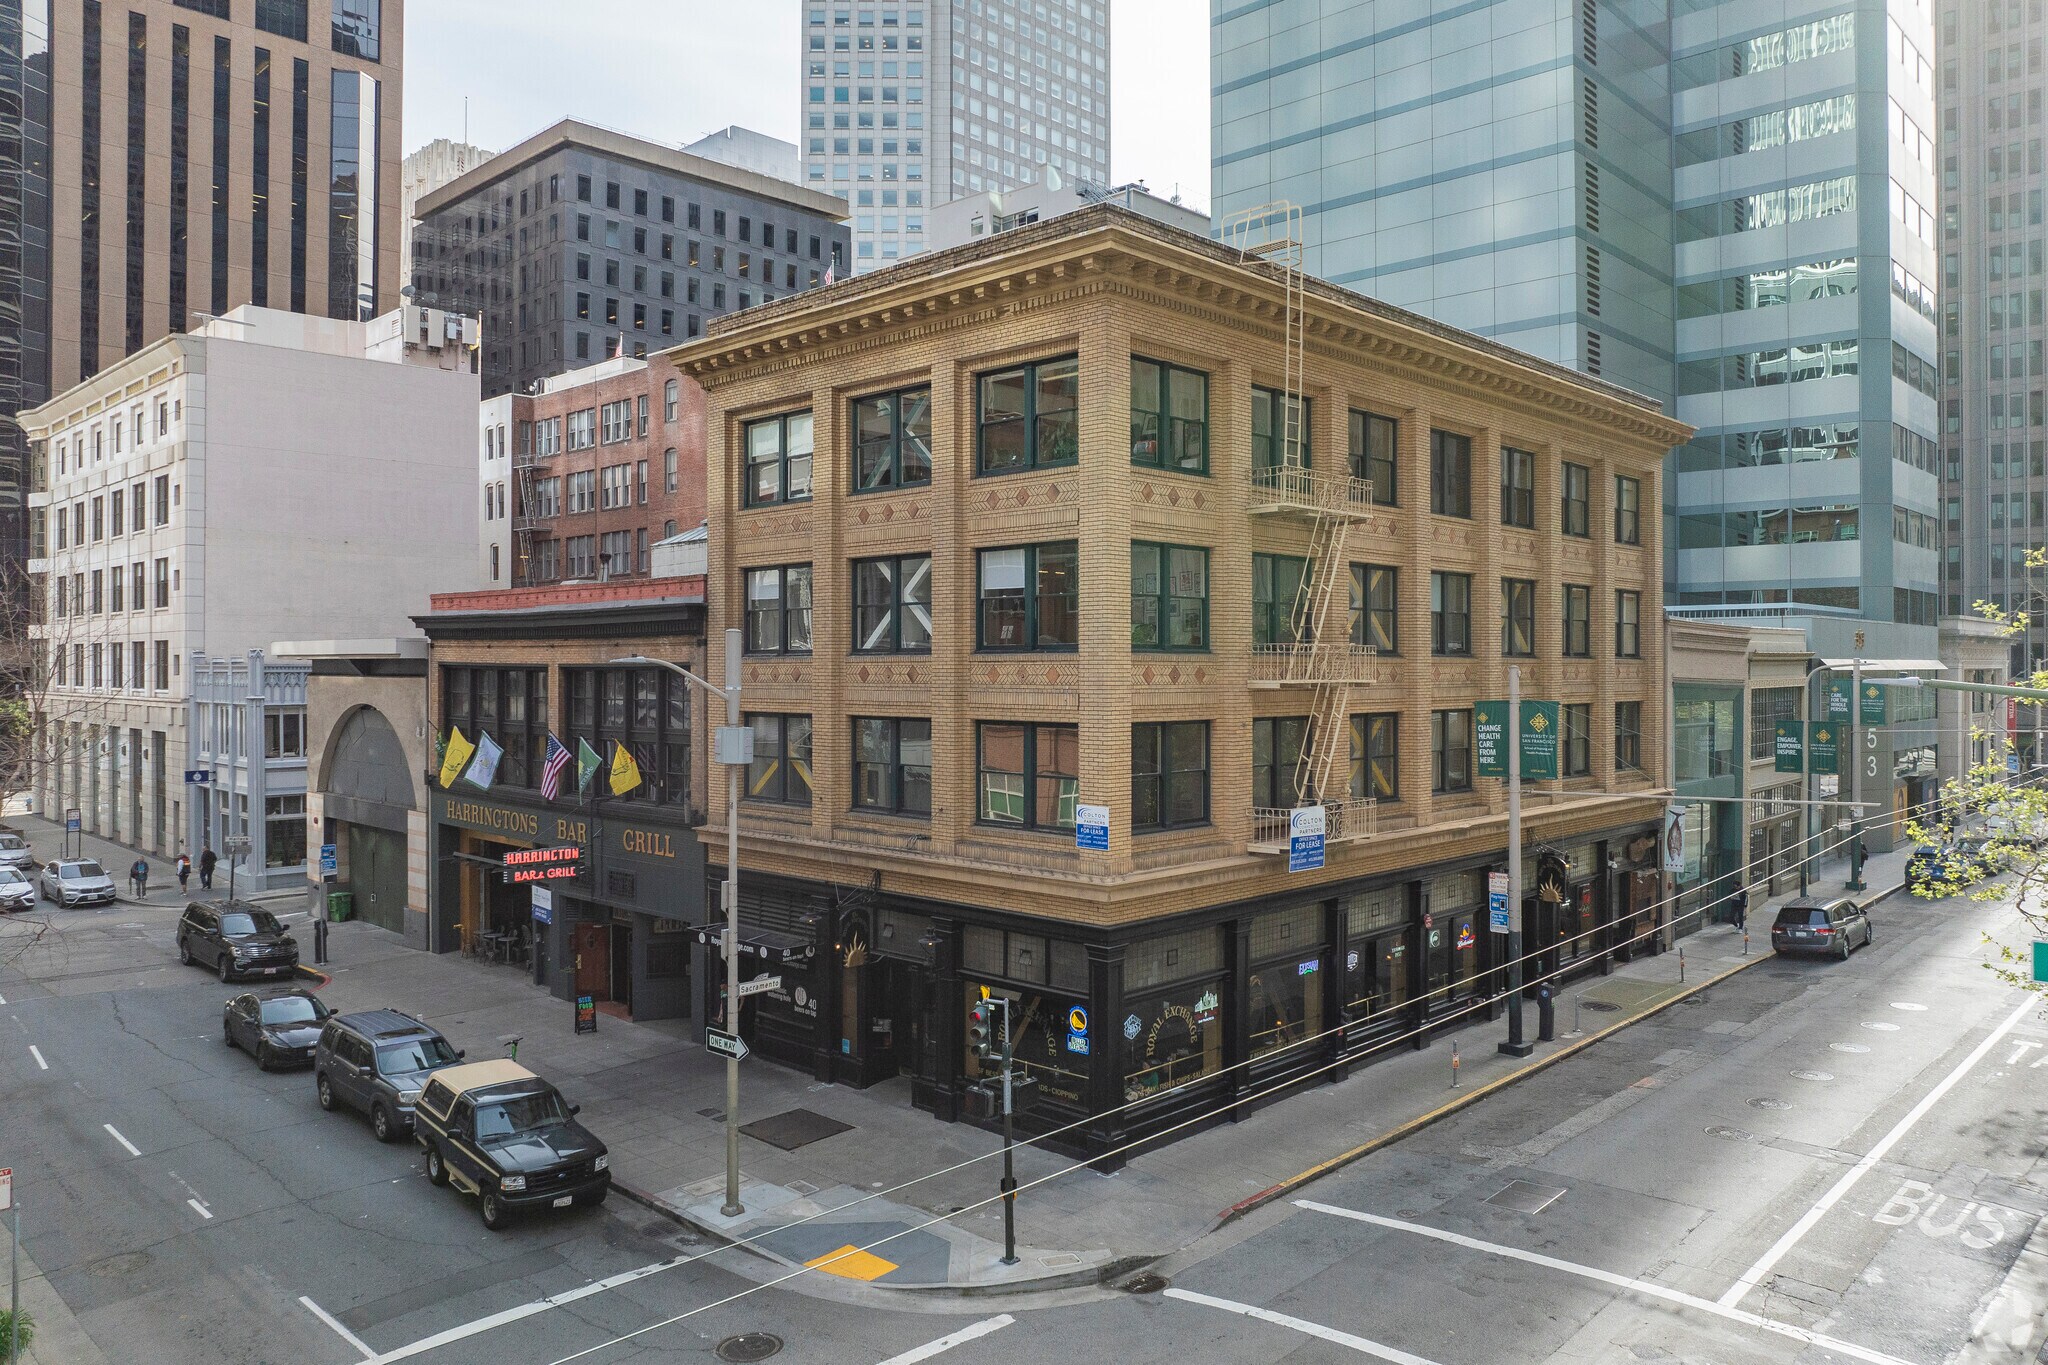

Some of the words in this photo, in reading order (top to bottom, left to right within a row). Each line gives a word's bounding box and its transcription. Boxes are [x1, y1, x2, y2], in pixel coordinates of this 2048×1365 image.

[1867, 728, 1877, 749] 5
[1867, 755, 1877, 777] 3
[446, 800, 538, 835] HARRINGTONS
[557, 819, 587, 843] BAR
[623, 829, 675, 858] GRILL
[1299, 817, 1323, 826] COLTON
[1299, 827, 1322, 835] PARTNERS
[1295, 842, 1306, 850] FOR
[1306, 840, 1321, 849] LEASE
[741, 981, 779, 994] Sacramento
[808, 999, 816, 1010] 40
[1146, 1016, 1165, 1057] ROYAL
[1164, 1006, 1198, 1044] EXCHANGE
[710, 1036, 722, 1048] ONE
[723, 1041, 736, 1052] WAY
[1872, 1180, 2005, 1249] BUS
